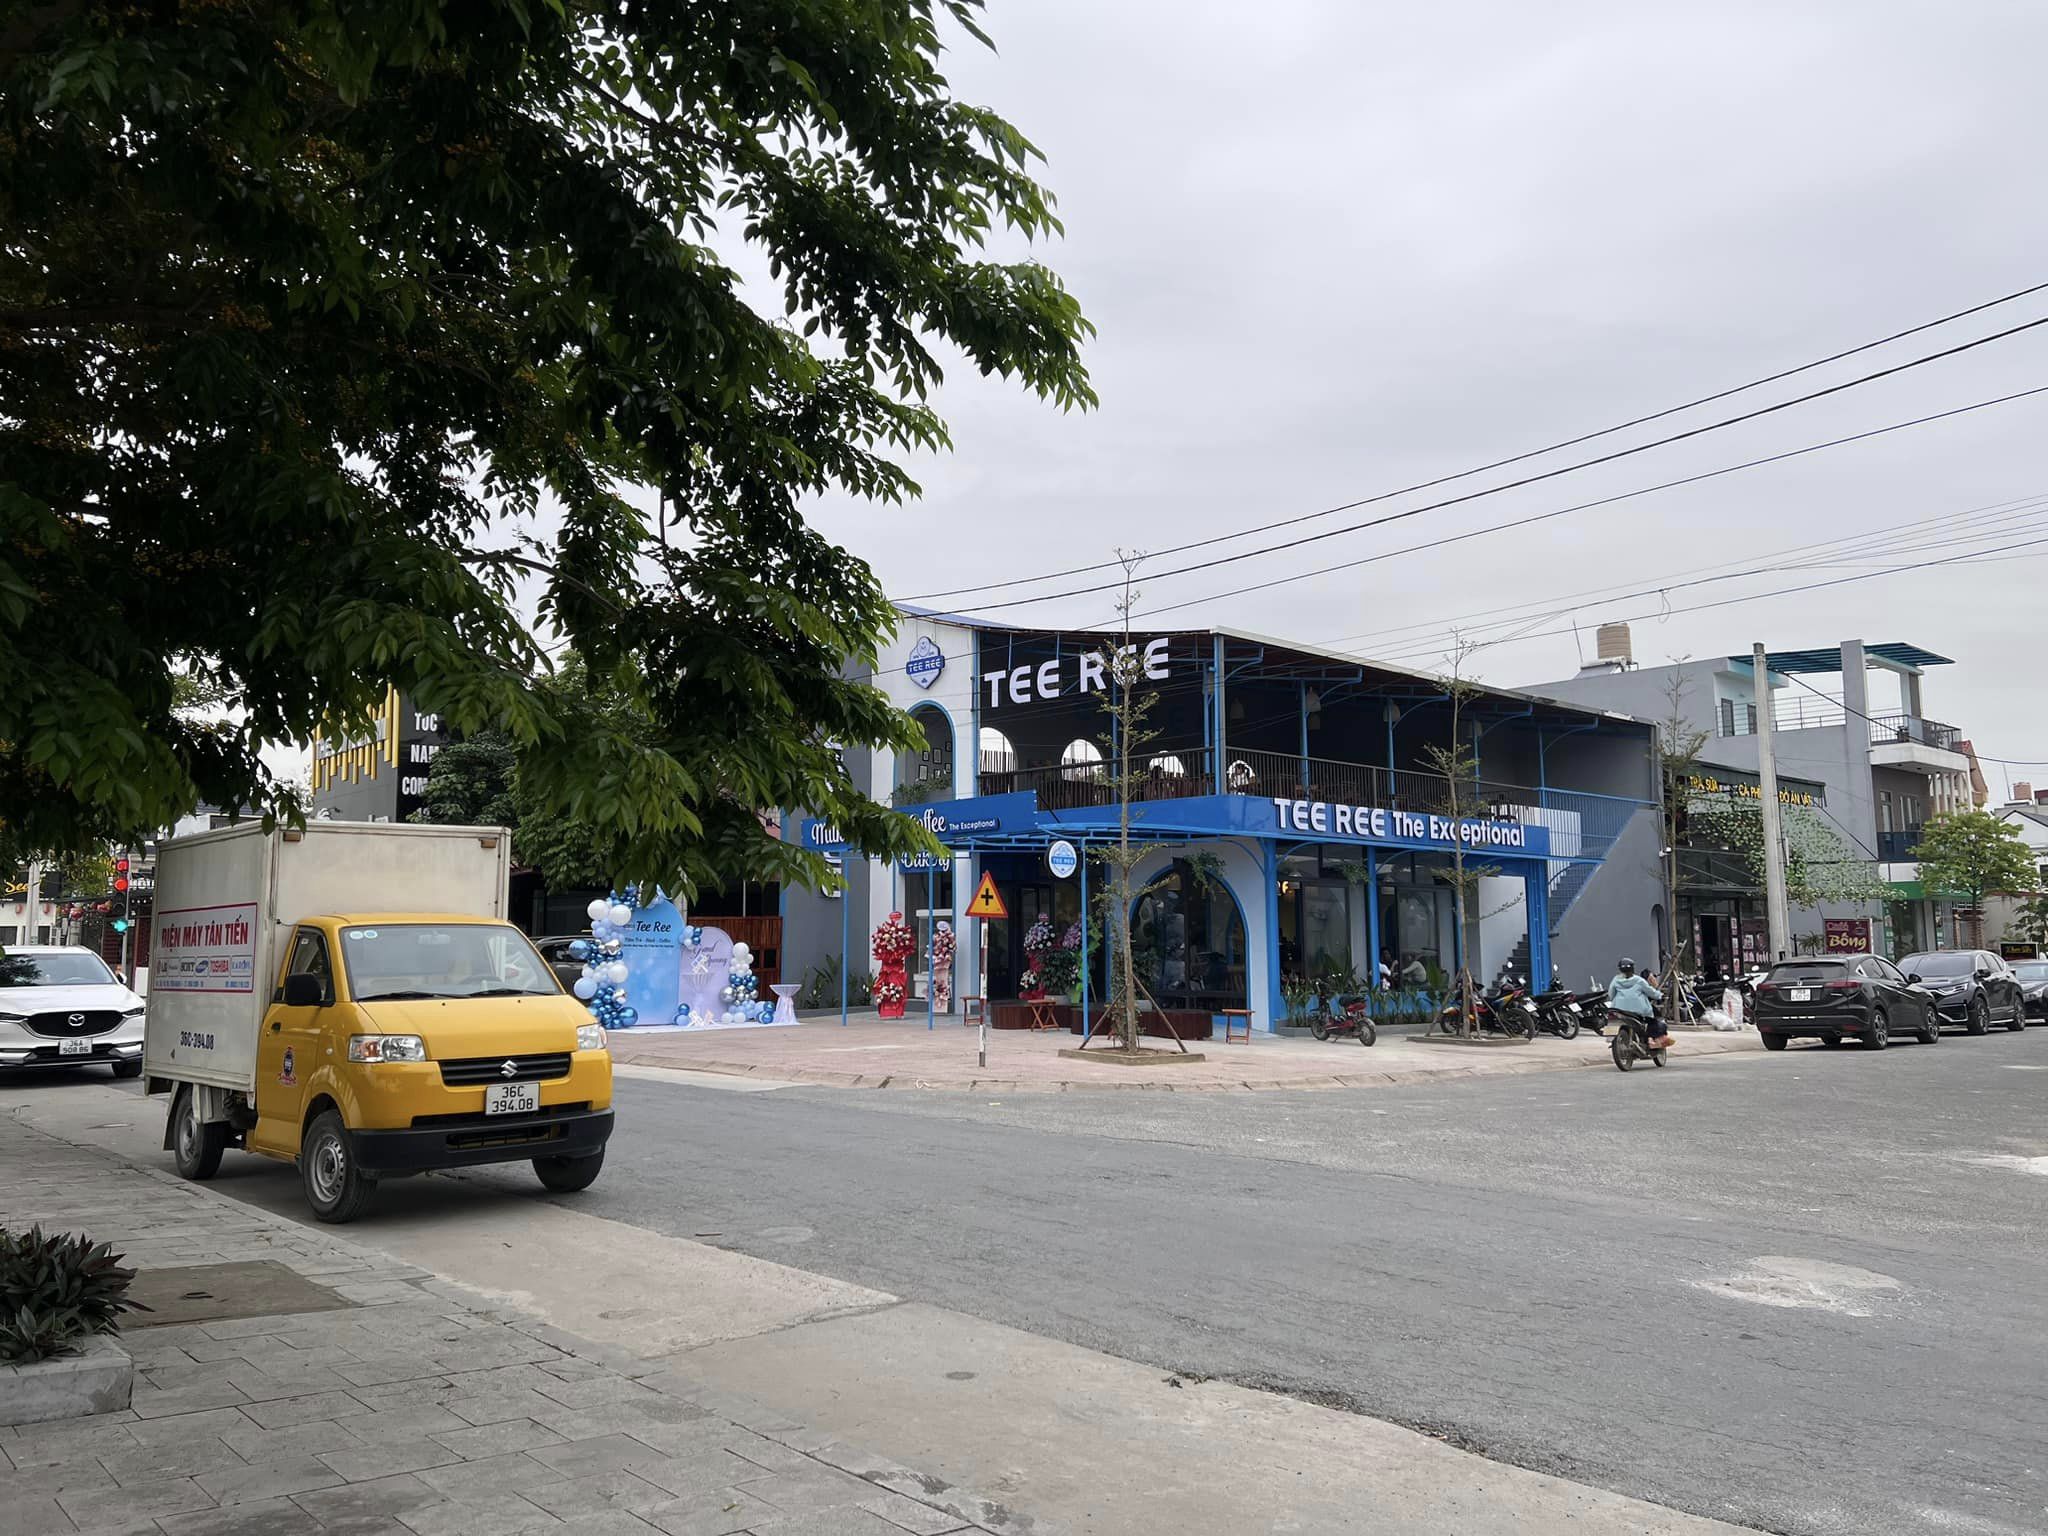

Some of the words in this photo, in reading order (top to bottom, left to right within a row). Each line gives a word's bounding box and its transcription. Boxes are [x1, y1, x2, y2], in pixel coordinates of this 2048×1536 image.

[984, 660, 1060, 708] TEE
[1080, 637, 1169, 693] REE
[949, 823, 959, 831] The
[960, 819, 996, 831] Exceptional
[1274, 798, 1327, 832] TEE
[1335, 804, 1386, 837] REE
[1392, 811, 1425, 839] The
[1430, 816, 1526, 848] Exceptional
[182, 921, 204, 947] MÁY
[204, 920, 222, 947] TÂN
[225, 914, 249, 946] TIẾN
[636, 920, 651, 933] Tee
[653, 920, 671, 933] Ree
[502, 1085, 525, 1098] 36C
[491, 1098, 533, 1112] 394.08
